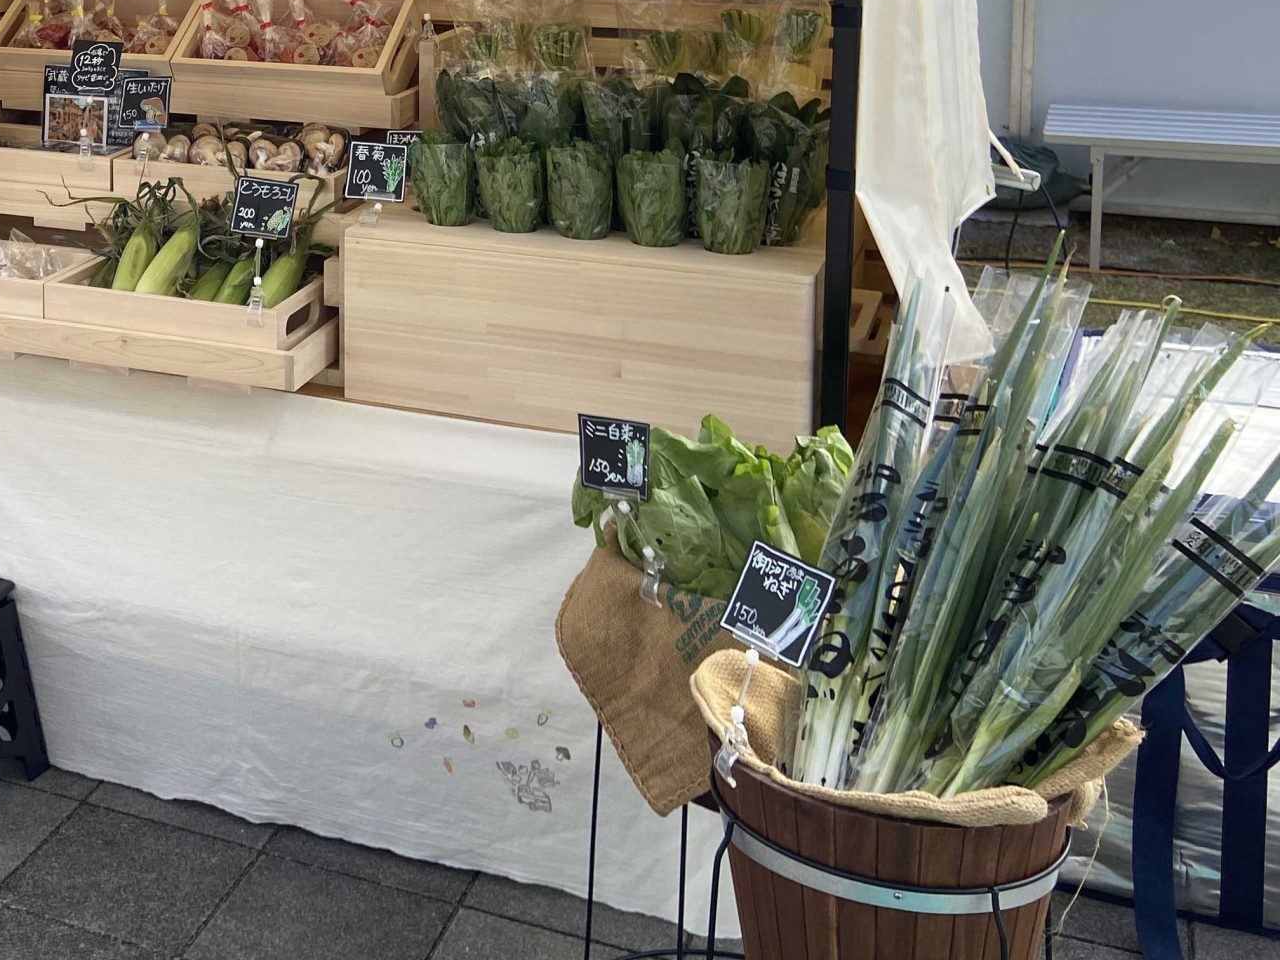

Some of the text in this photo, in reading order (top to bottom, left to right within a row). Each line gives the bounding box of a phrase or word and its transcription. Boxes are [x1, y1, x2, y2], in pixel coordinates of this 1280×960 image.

[80, 54, 104, 67] 12秒
[126, 81, 167, 95] 生しいたけ
[122, 109, 138, 121] 150
[355, 144, 384, 161] 春菊
[353, 168, 371, 184] 100
[240, 180, 295, 202] とうもろこし
[360, 183, 378, 194] yen
[237, 206, 256, 219] 200
[240, 221, 256, 229] yen
[585, 420, 634, 443] ミニ白菜
[588, 457, 610, 474] 150
[604, 472, 626, 484] yen
[763, 576, 798, 600] ねぎ
[733, 601, 758, 625] 150
